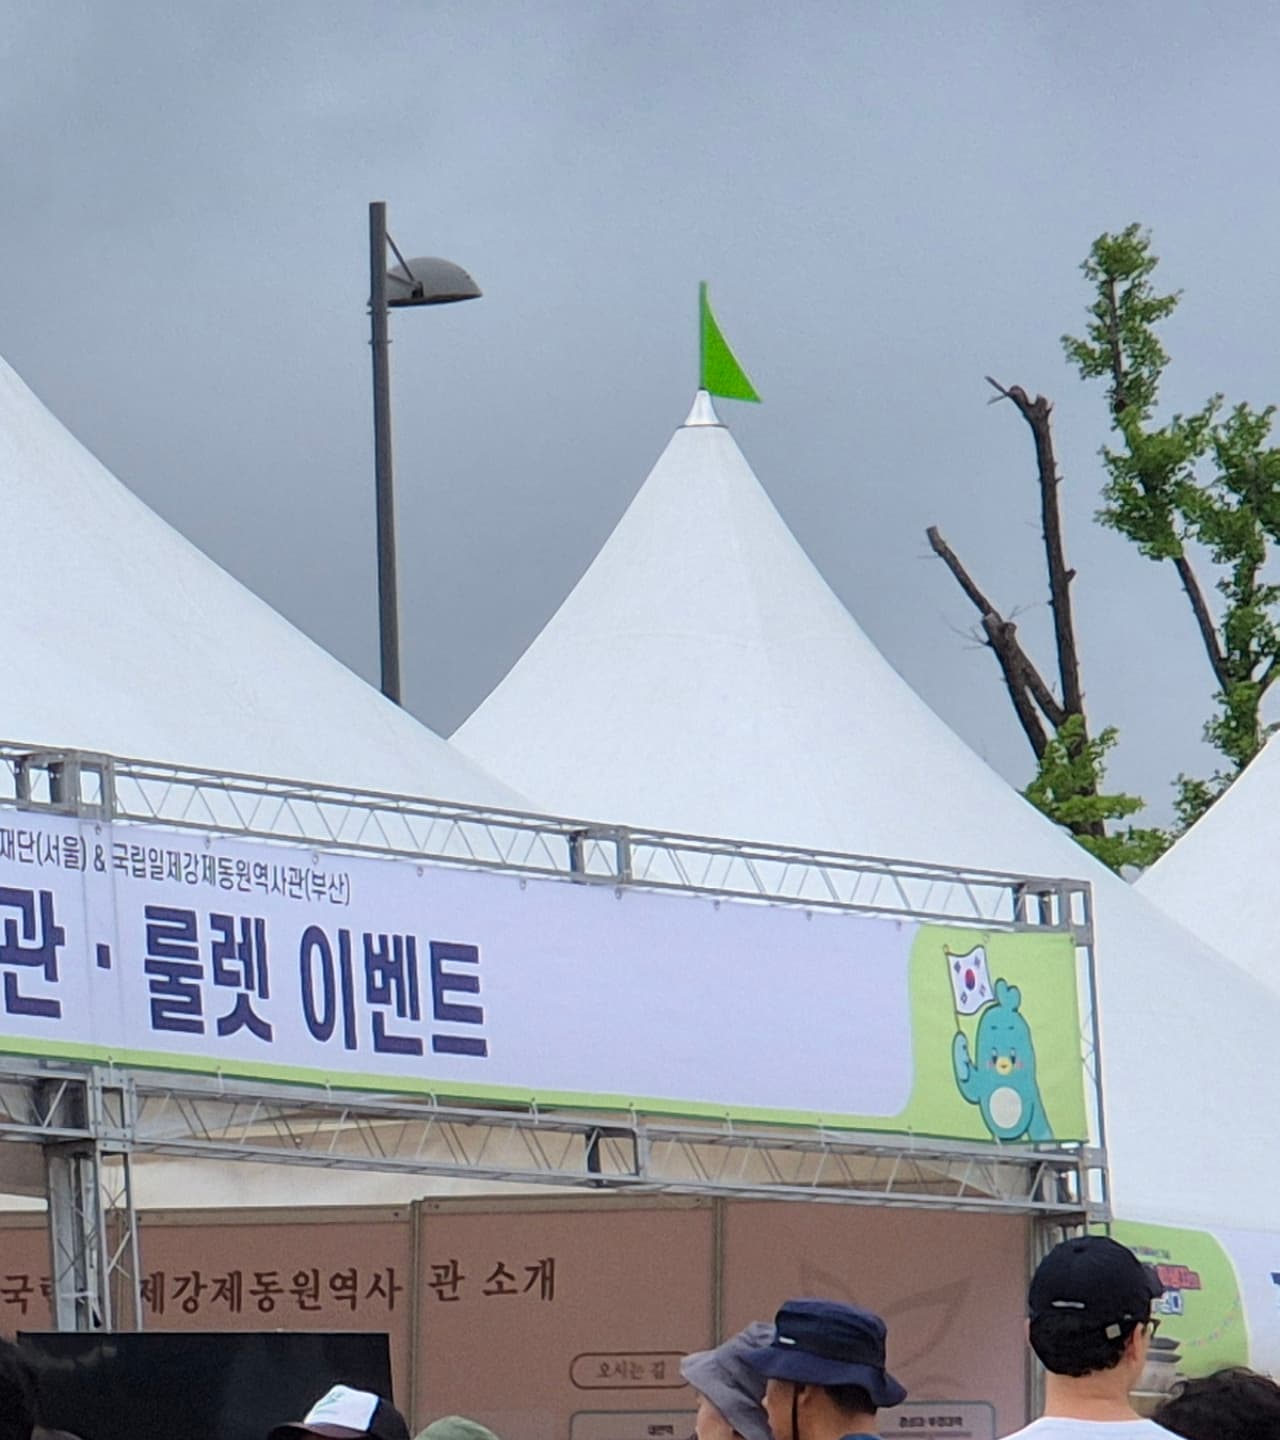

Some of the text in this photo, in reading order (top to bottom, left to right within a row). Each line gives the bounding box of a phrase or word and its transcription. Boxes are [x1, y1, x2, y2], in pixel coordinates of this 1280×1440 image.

[93, 844, 107, 873] &
[112, 841, 351, 906] 국립일제강제동원역사관(부산)
[143, 904, 273, 1044] 룰렛
[299, 923, 489, 1058] 이벤트
[481, 1256, 556, 1302] 소개
[597, 1359, 666, 1380] 오시는 길
